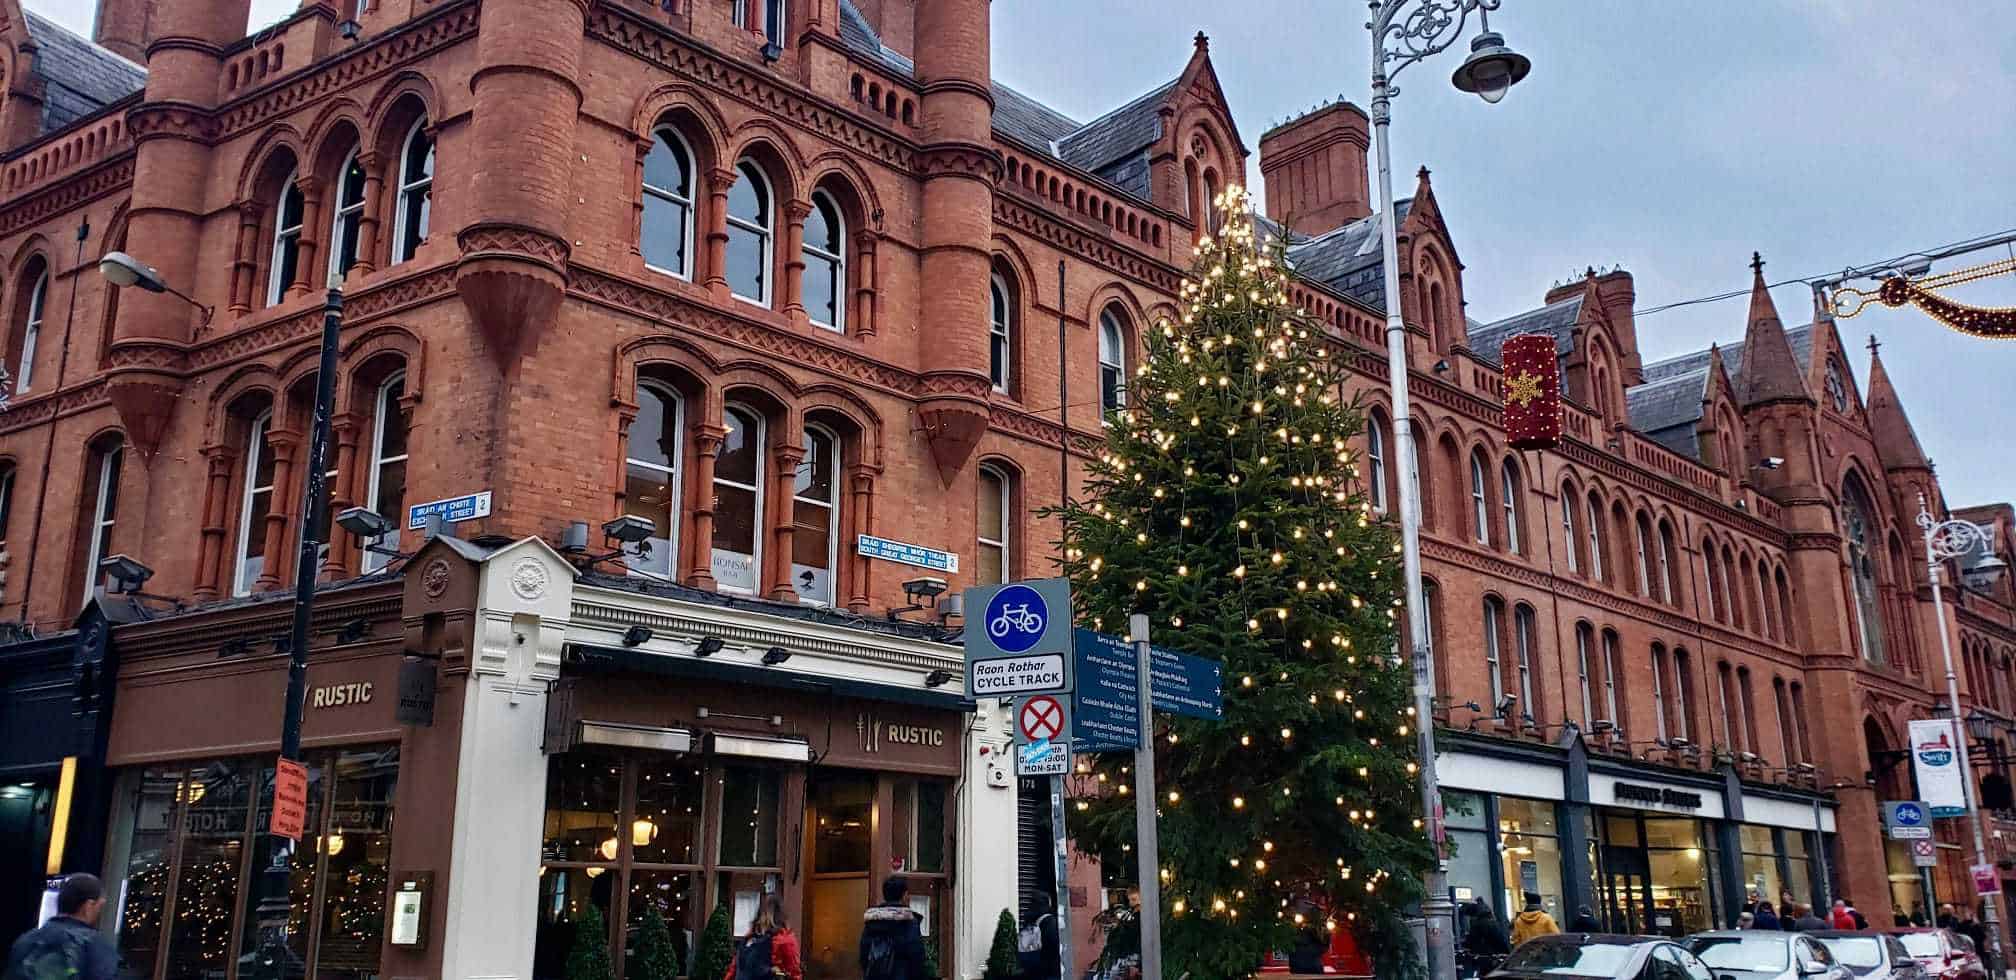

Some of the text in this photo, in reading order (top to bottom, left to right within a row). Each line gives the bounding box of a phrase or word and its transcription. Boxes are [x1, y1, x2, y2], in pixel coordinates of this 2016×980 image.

[976, 661, 1046, 675] Raon Rothar
[977, 671, 1061, 689] CYCLE TRACK
[313, 681, 373, 708] RUSTIC
[887, 724, 943, 747] RUSTIC
[1024, 763, 1062, 773] MON-SAT
